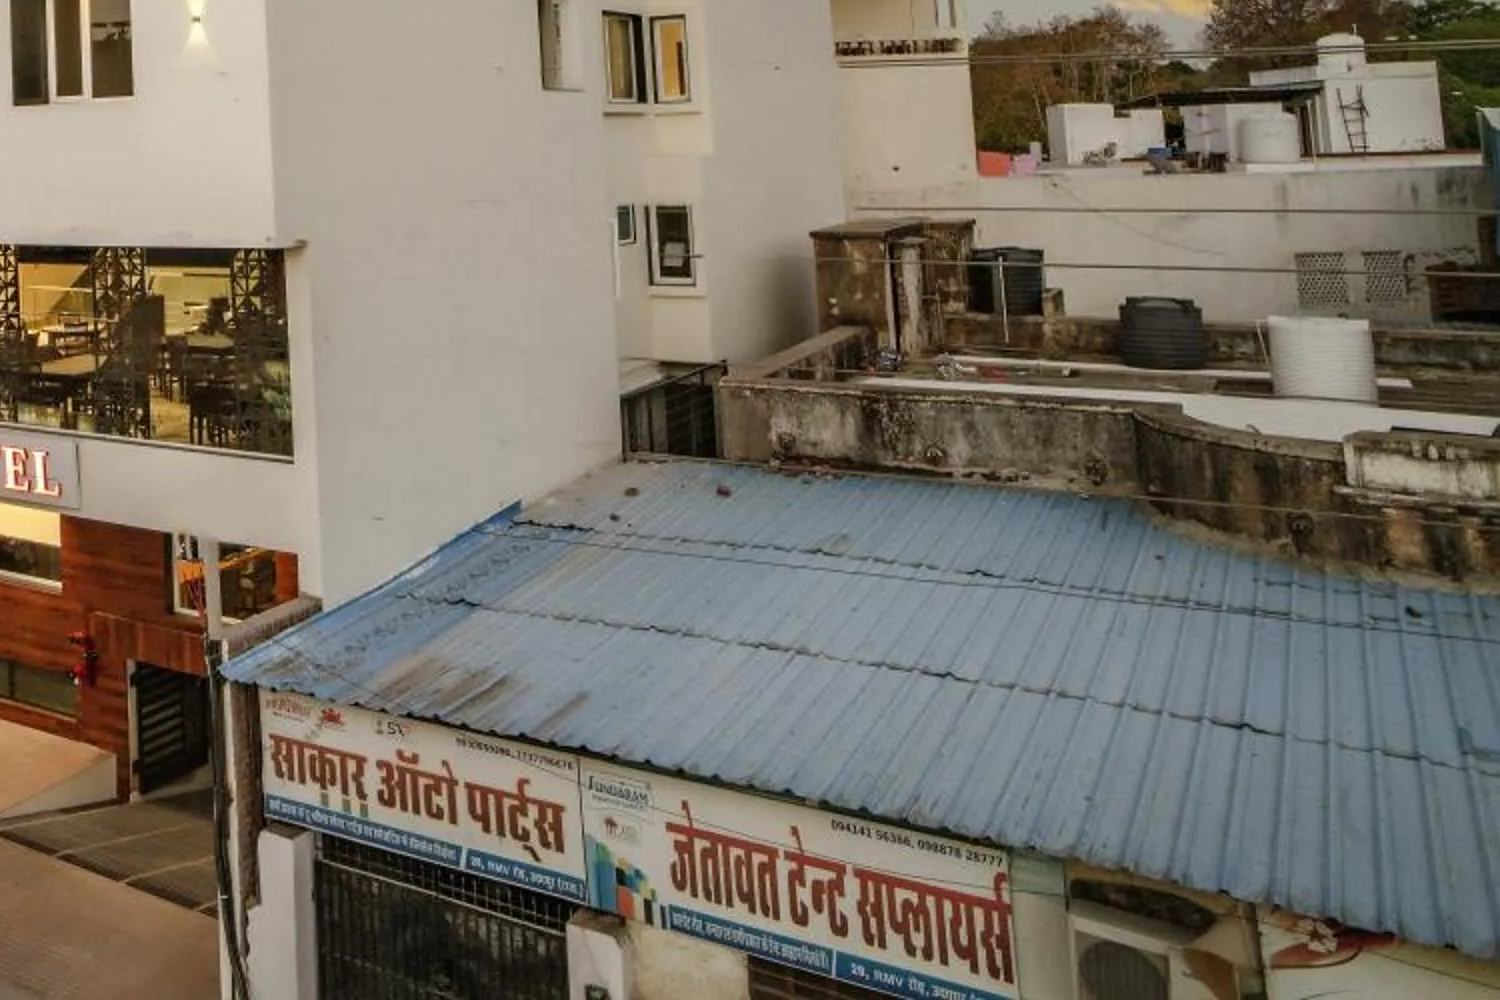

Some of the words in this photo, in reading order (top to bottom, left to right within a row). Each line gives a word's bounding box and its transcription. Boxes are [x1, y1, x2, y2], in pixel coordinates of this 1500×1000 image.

[268, 733, 368, 801] साकार
[376, 748, 459, 825] ऑटो
[464, 777, 566, 862] पार्ट्स
[666, 800, 780, 921] जेतावत
[784, 825, 849, 938] टेन्ट
[853, 871, 1015, 985] सप्लायर्स
